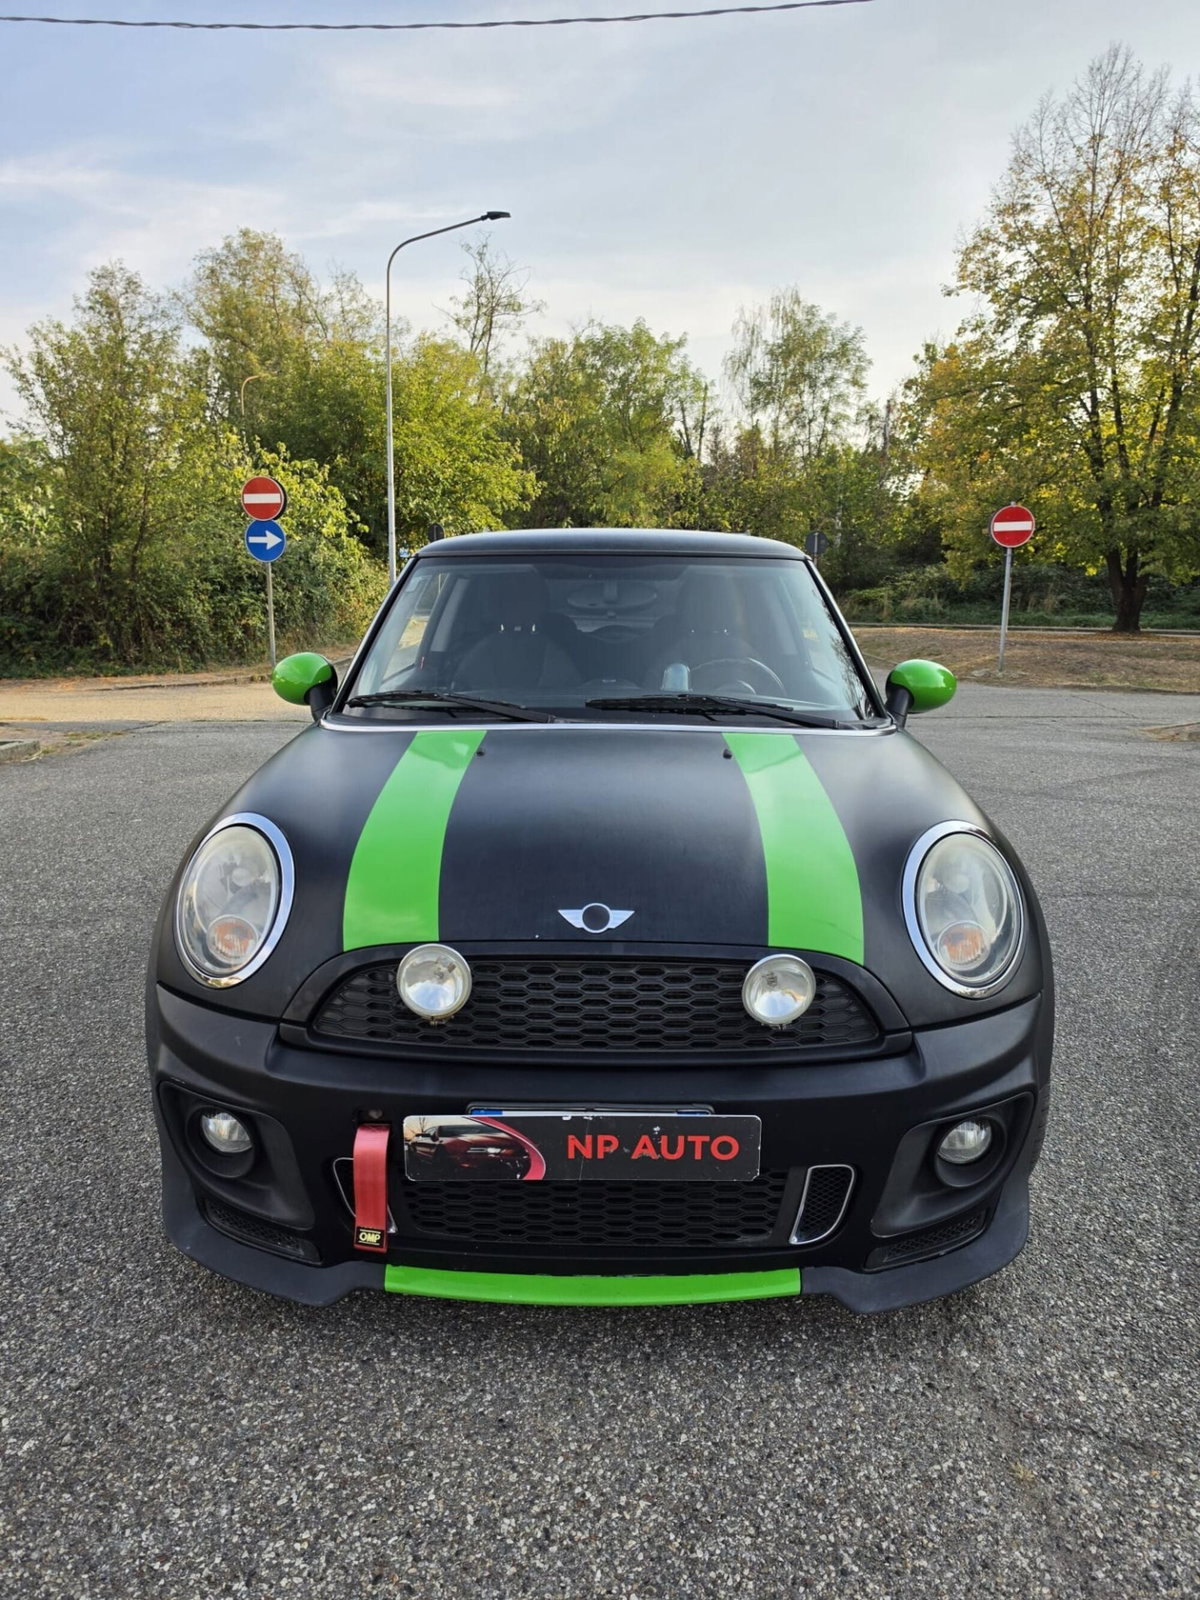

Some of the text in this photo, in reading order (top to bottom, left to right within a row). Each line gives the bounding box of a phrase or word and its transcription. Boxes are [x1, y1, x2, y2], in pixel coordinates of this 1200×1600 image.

[567, 1135, 739, 1161] NP AUTO
[359, 1232, 381, 1243] OMP
